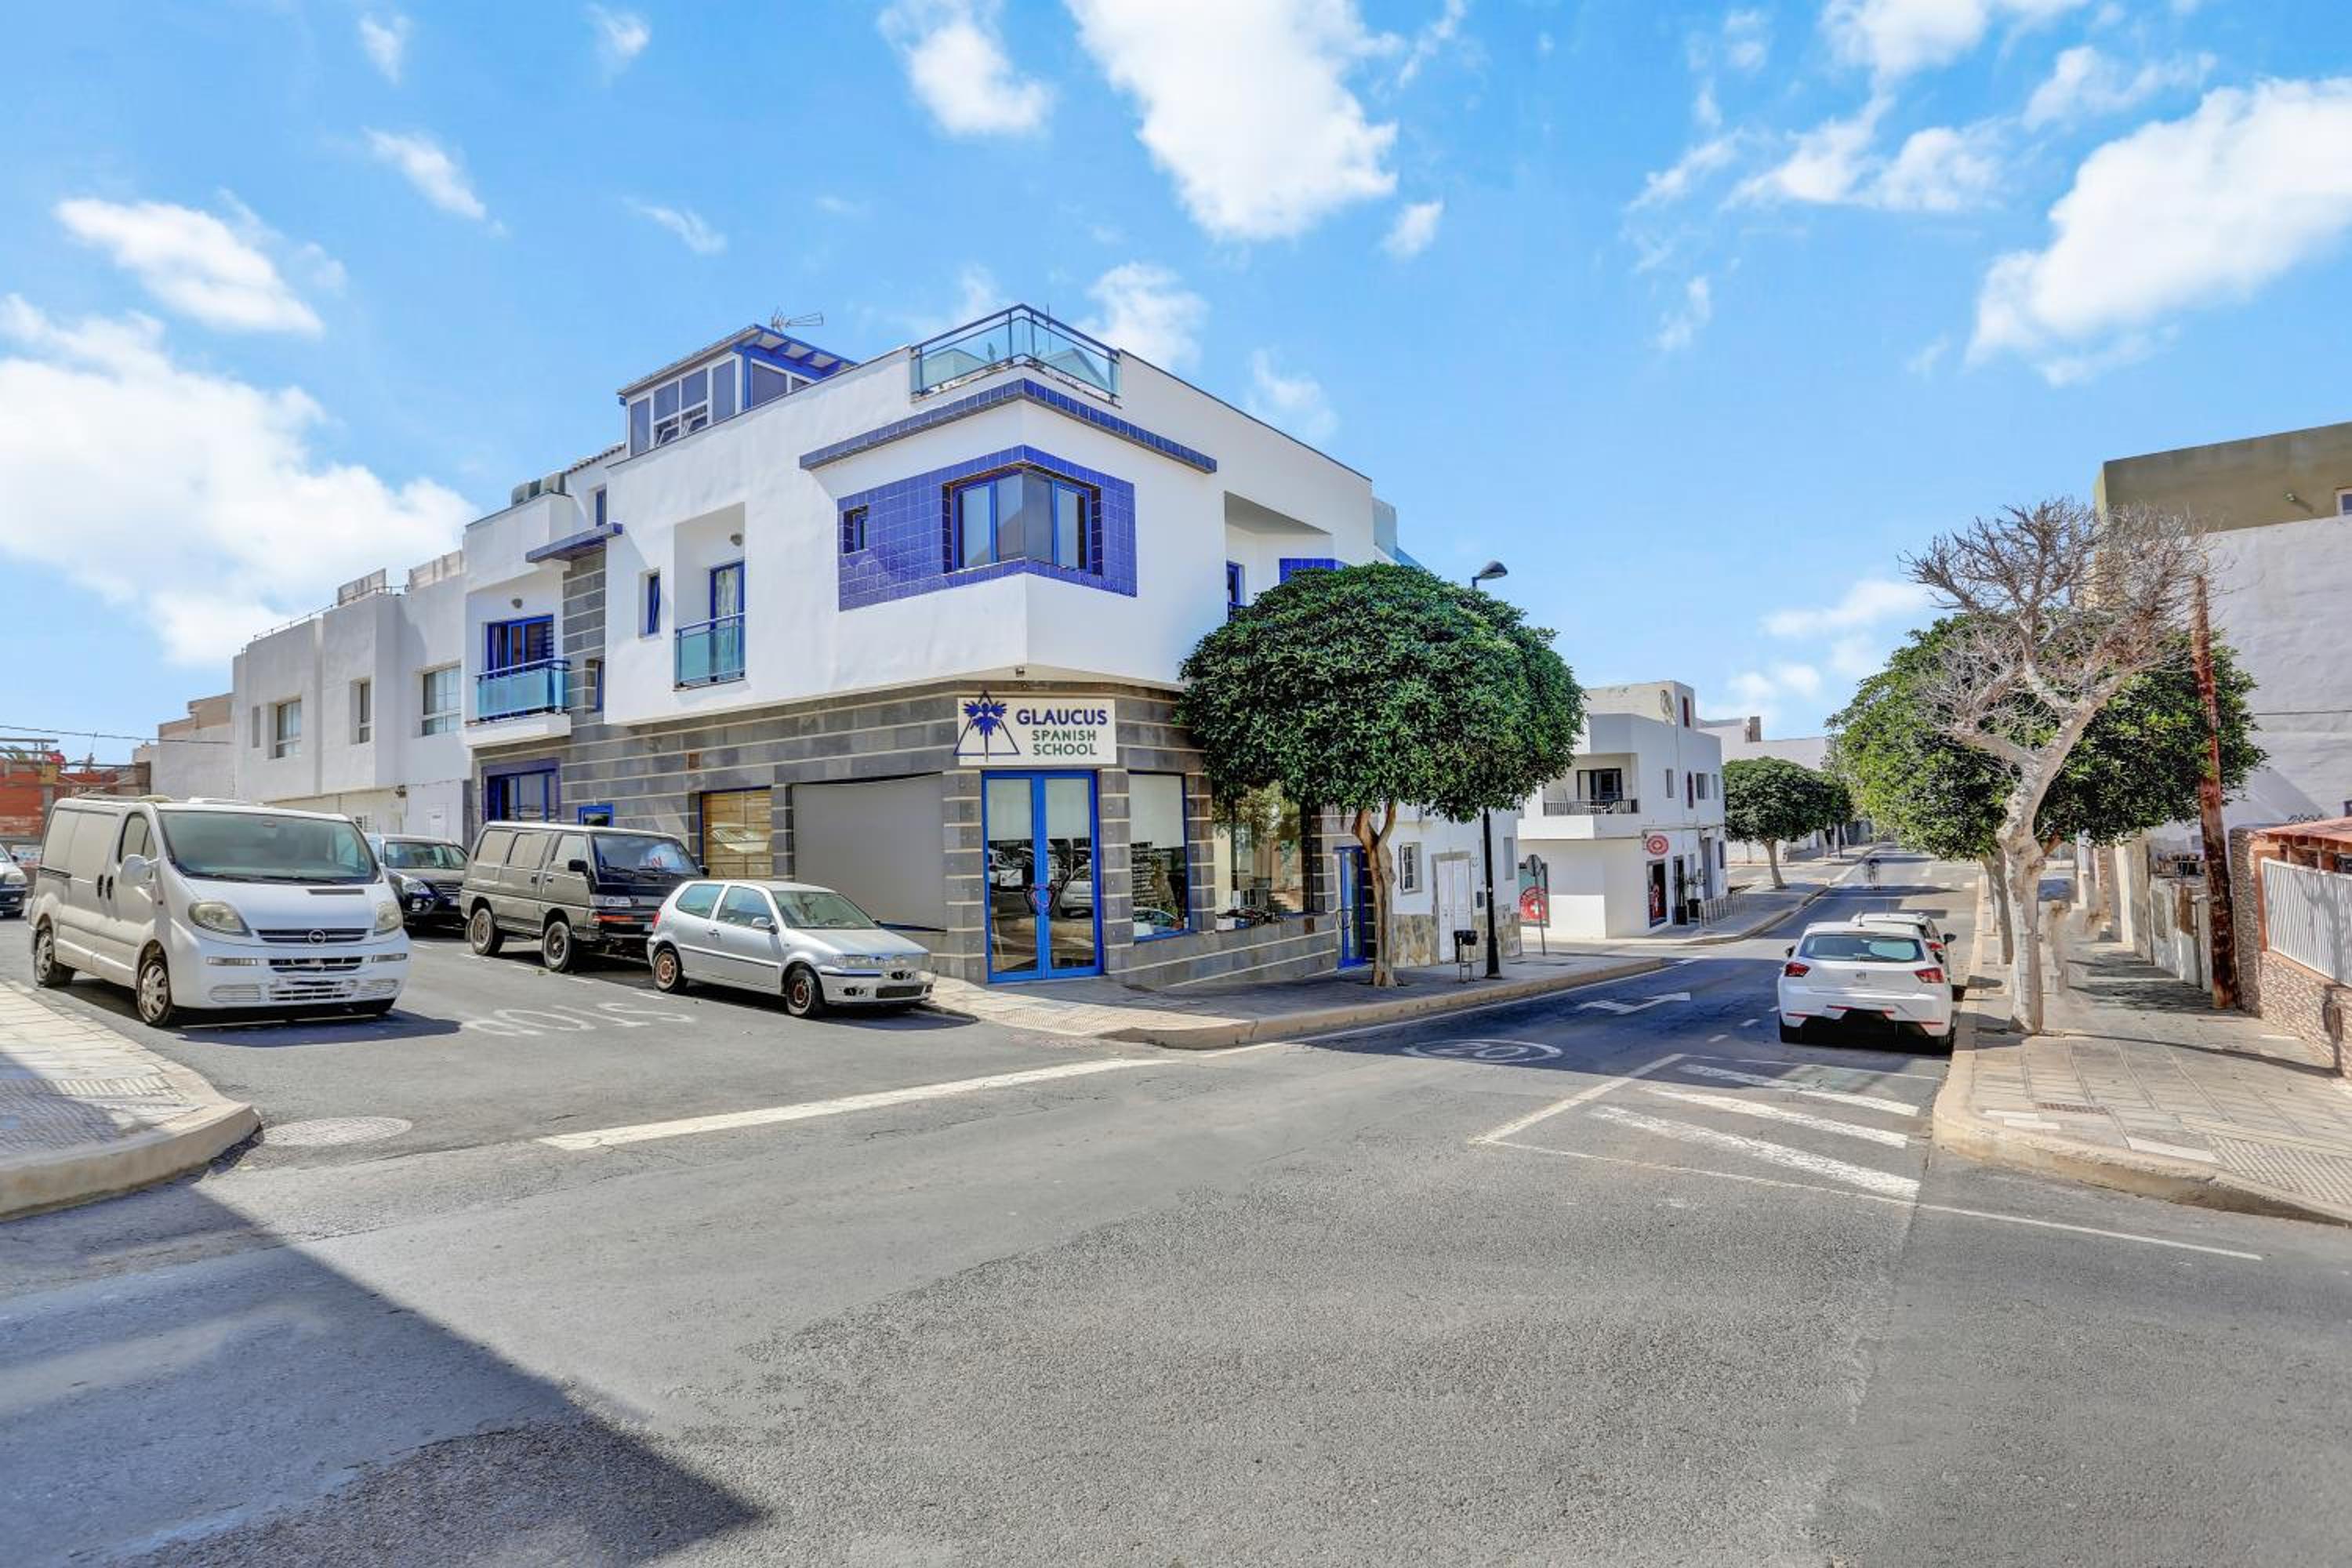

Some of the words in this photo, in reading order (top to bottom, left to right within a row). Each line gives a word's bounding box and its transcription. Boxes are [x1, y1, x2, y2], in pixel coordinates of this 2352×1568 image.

[1016, 709, 1107, 725] GLAUCUS
[1032, 730, 1097, 741] SPANISH
[1033, 743, 1098, 756] SCHOOL
